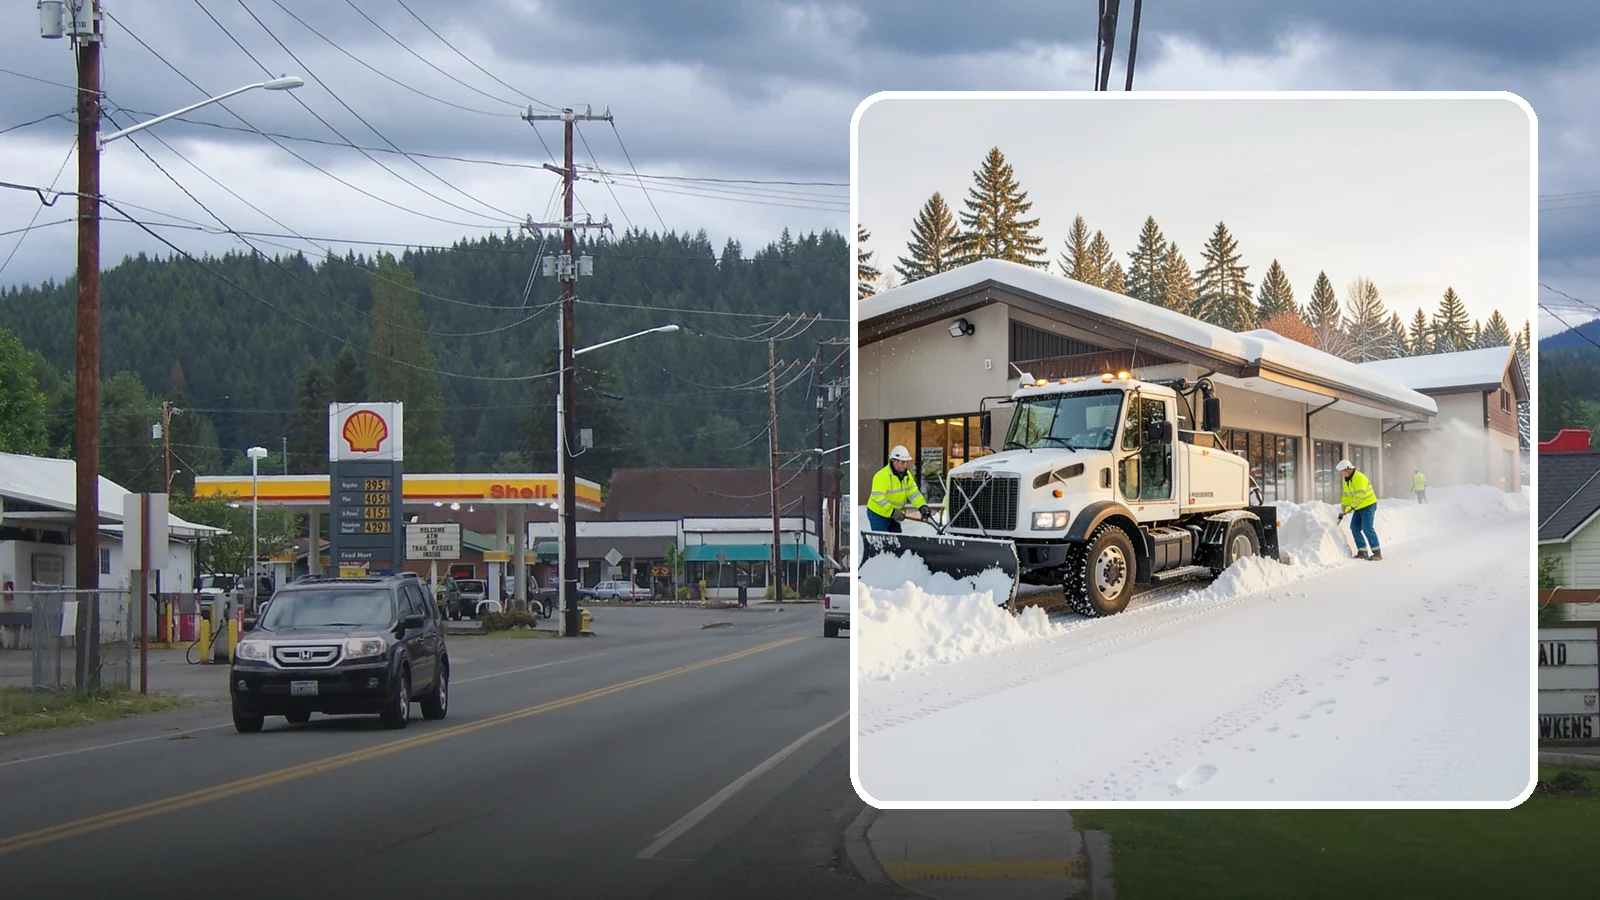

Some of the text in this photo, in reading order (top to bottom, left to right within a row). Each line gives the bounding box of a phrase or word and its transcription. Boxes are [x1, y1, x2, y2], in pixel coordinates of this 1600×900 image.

[490, 484, 547, 499] Shell
[1538, 642, 1567, 665] AID
[1538, 715, 1592, 739] WKENS
